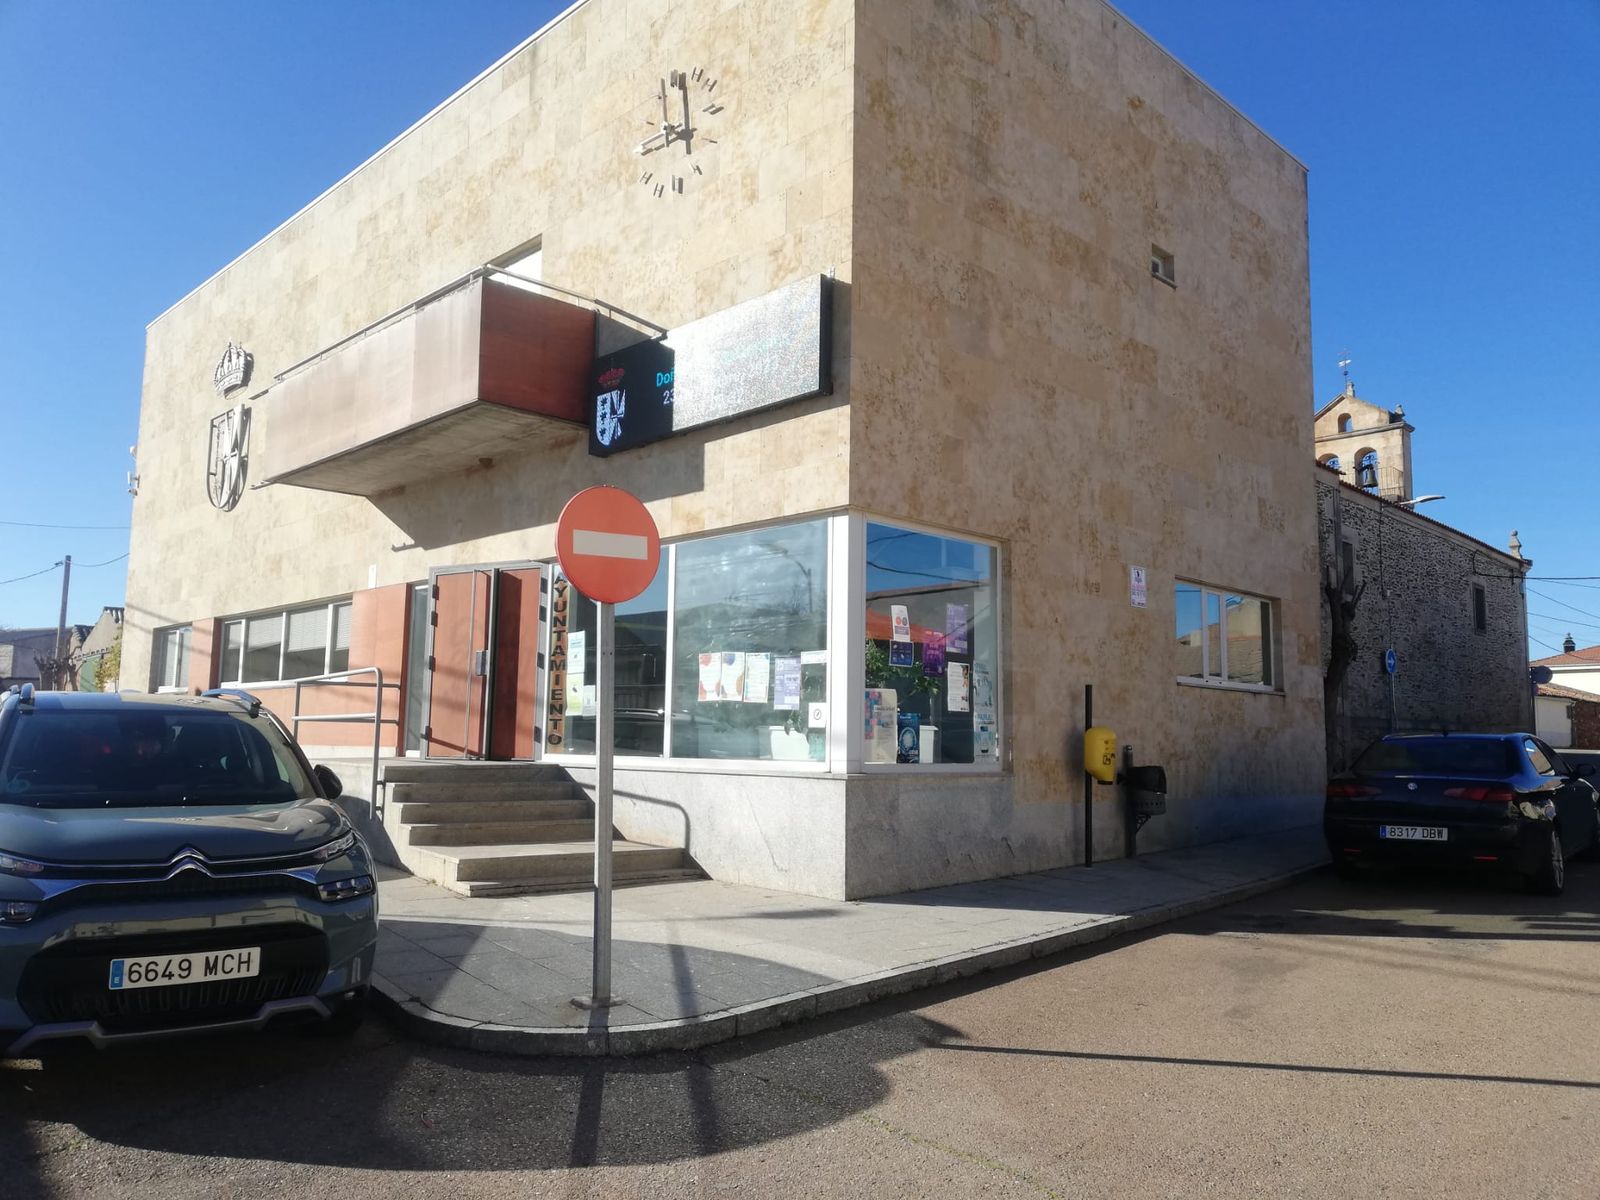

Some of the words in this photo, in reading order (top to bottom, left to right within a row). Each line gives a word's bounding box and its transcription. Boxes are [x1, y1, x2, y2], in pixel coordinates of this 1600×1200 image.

[548, 573, 567, 746] AYUNTAMIENTO
[1389, 827, 1417, 839] 8317
[1422, 828, 1444, 840] DBW
[127, 958, 193, 984] 6649
[203, 951, 252, 977] MCH
